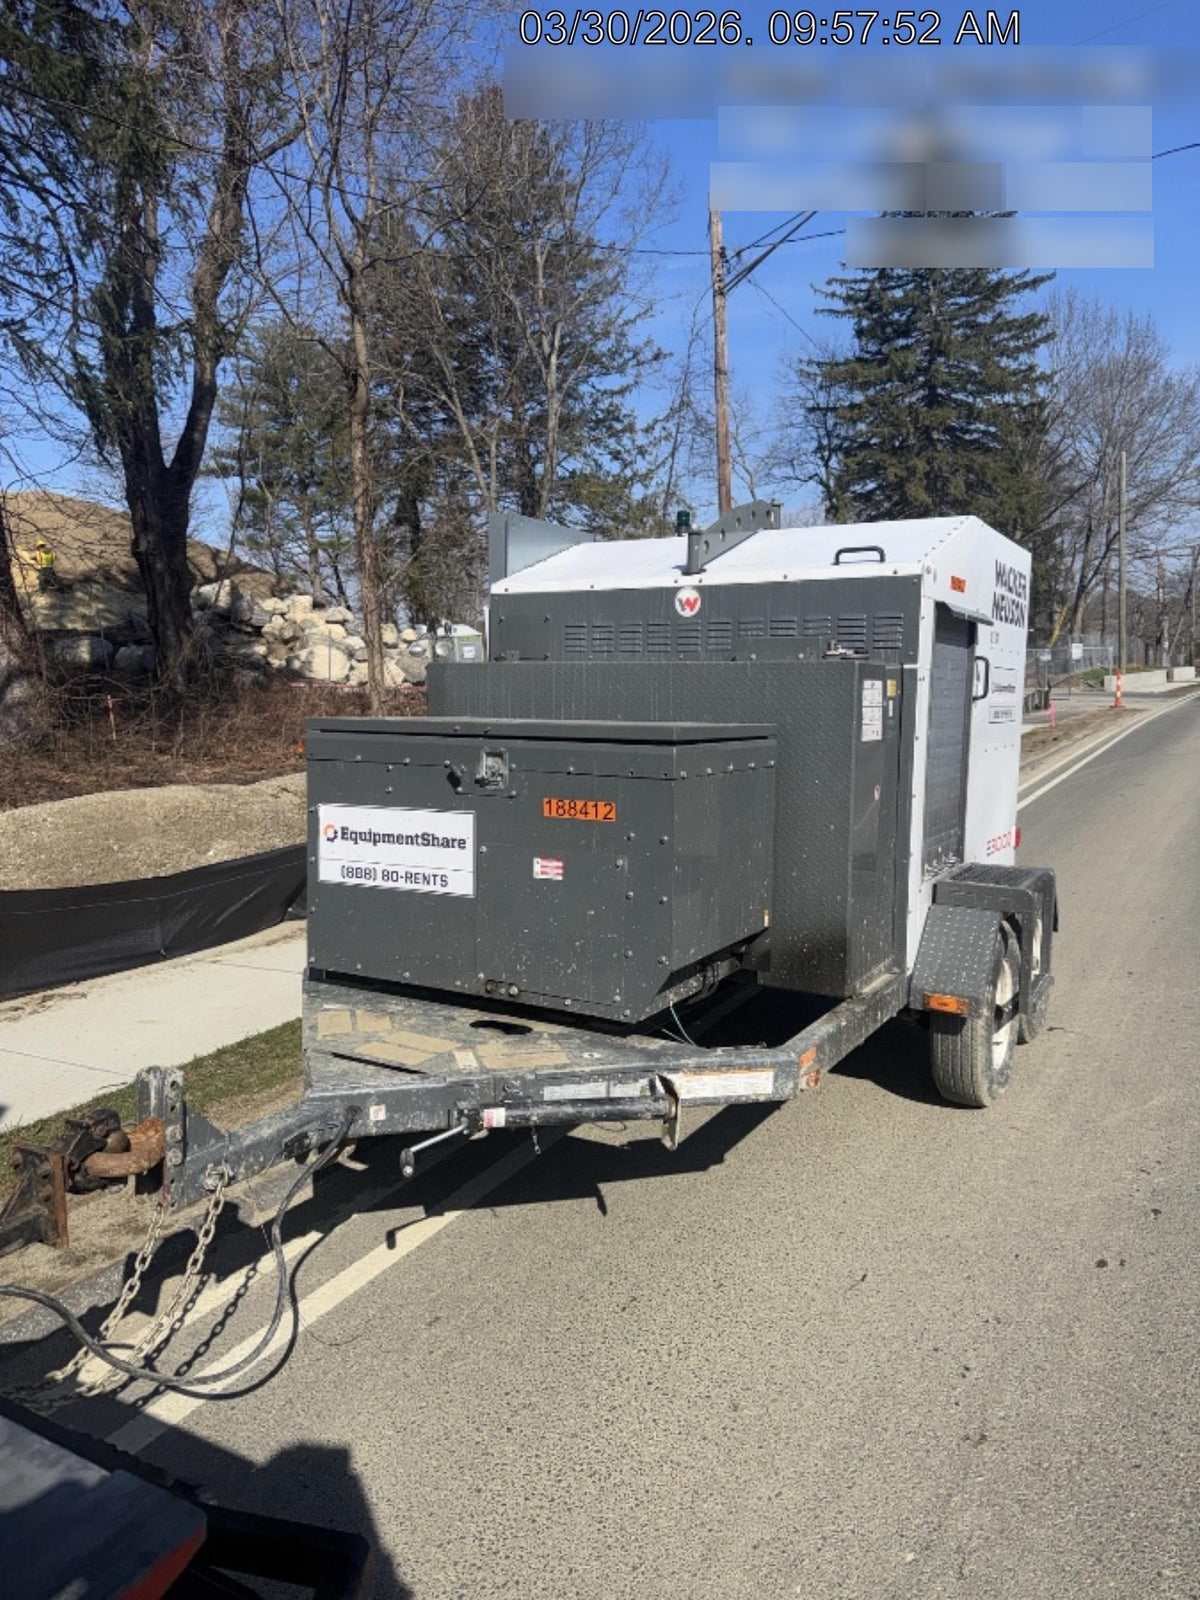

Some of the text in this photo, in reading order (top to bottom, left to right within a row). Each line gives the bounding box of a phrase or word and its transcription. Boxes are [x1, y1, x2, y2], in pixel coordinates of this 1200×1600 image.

[995, 559, 1027, 601] WACKER
[992, 591, 1025, 629] NEUSON
[545, 799, 614, 820] 188412
[340, 826, 467, 849] EquipmentShare
[341, 865, 449, 887] (888) 80-RENTS
